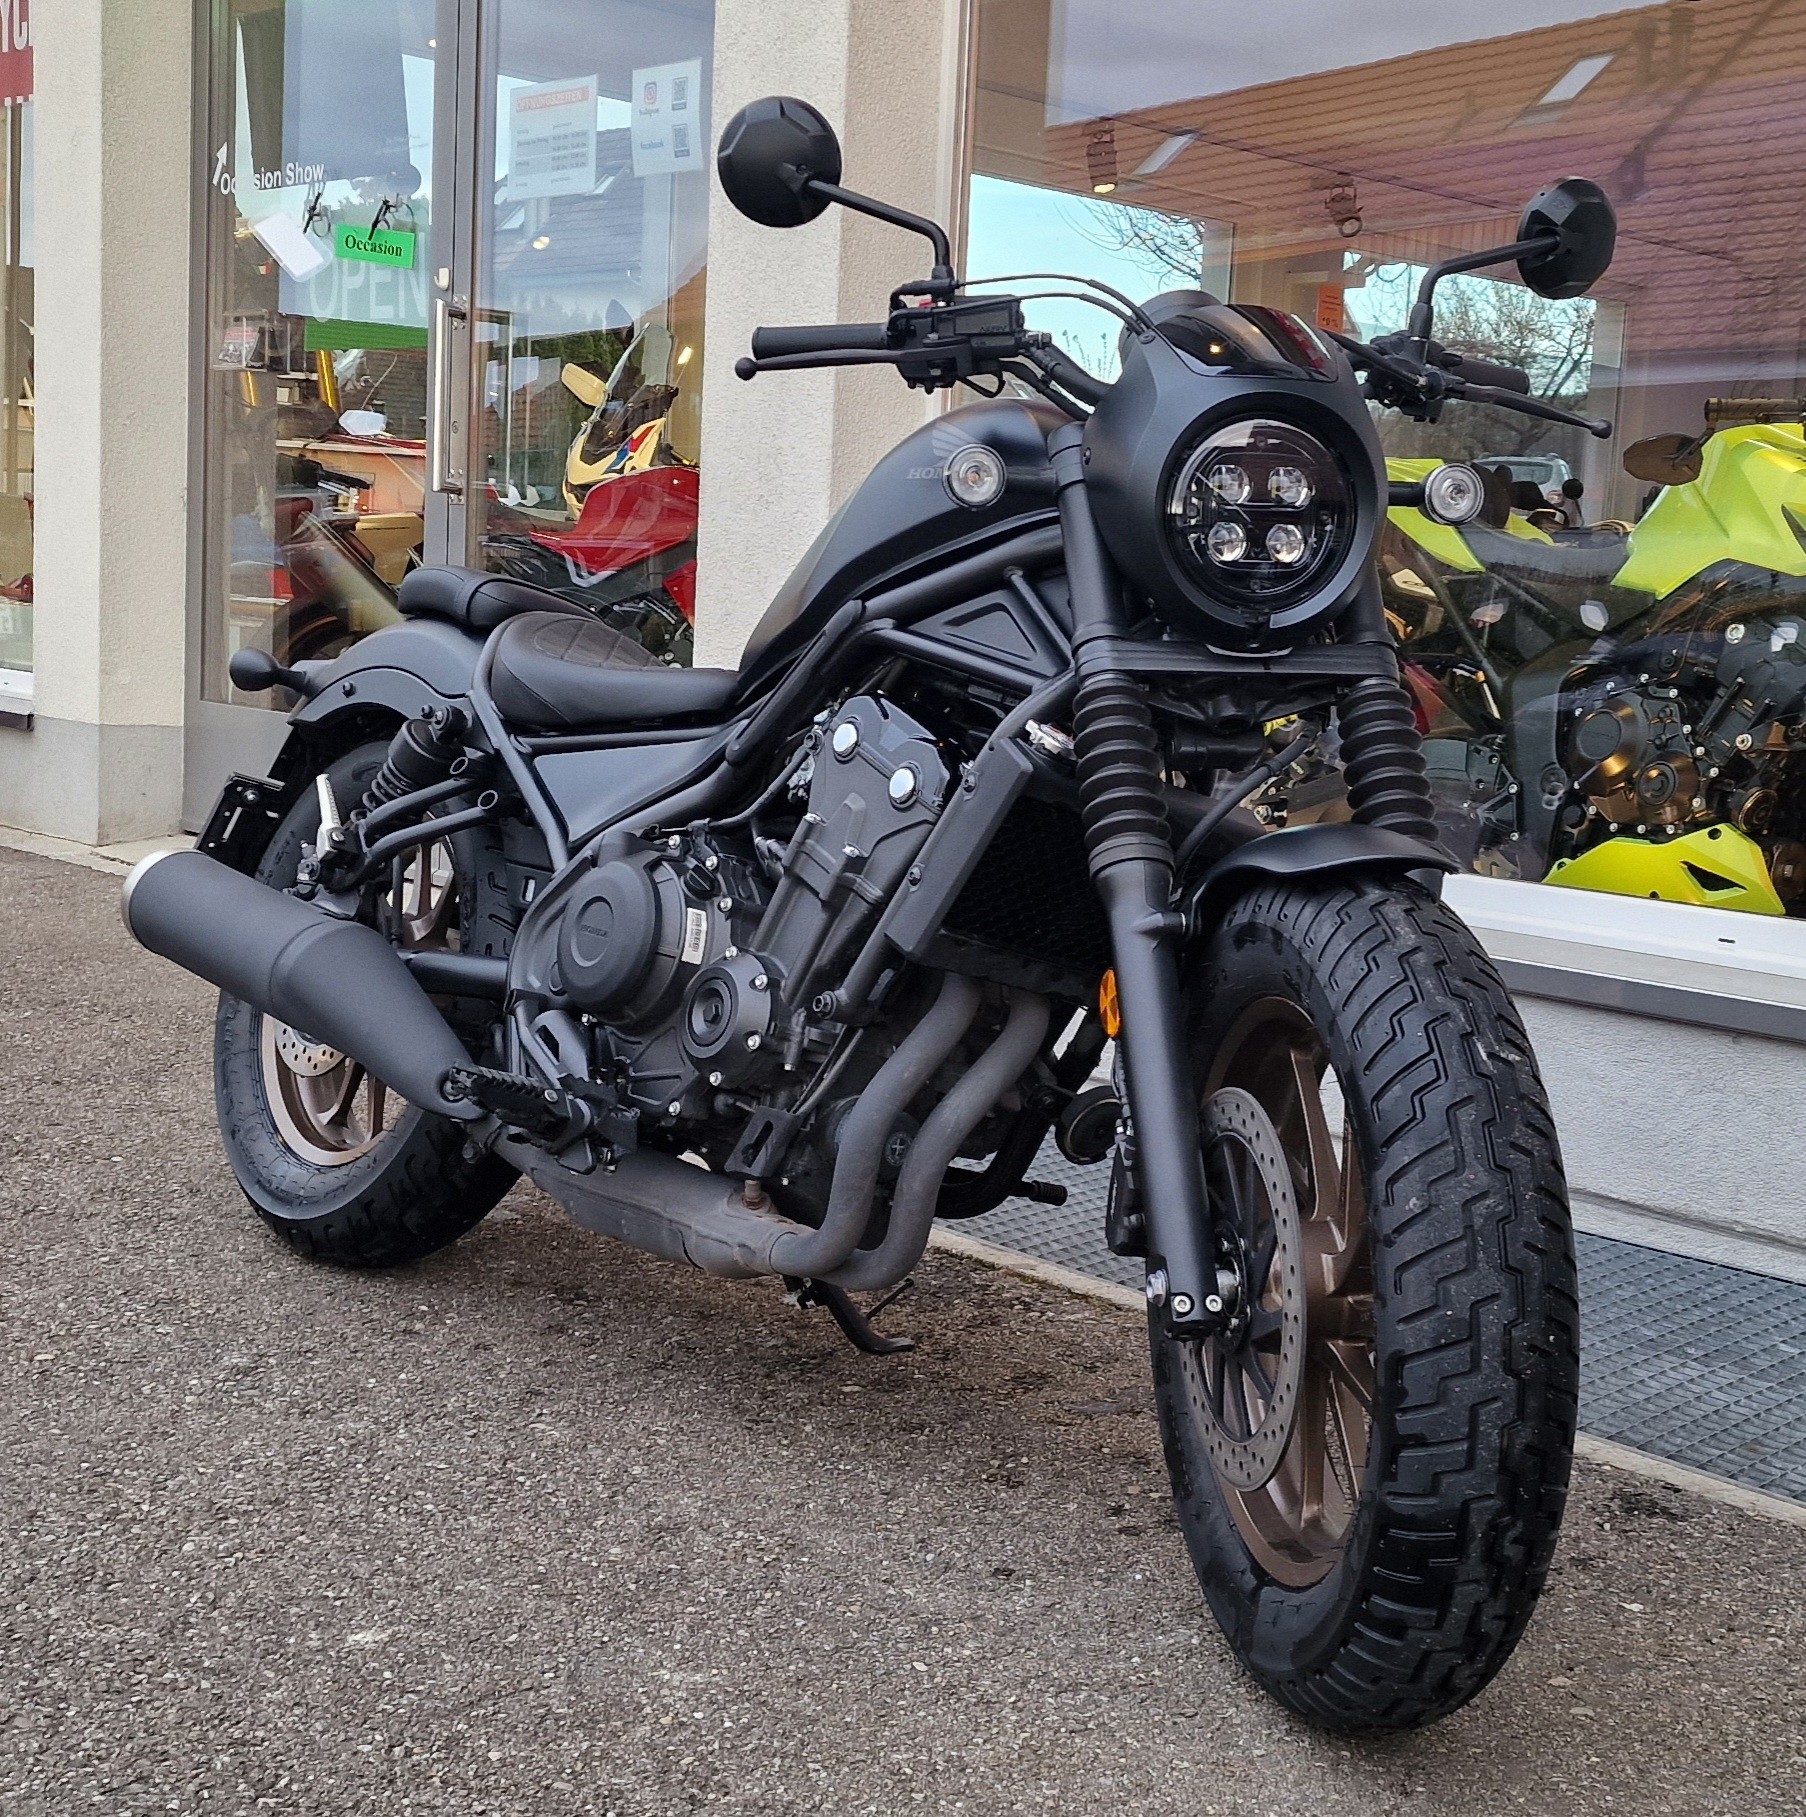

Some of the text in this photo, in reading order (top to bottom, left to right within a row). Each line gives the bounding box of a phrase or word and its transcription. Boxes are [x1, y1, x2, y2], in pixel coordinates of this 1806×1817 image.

[0, 0, 33, 52] YC
[220, 162, 325, 195] Ocsion Show
[345, 234, 403, 257] Occasion
[309, 232, 428, 323] OPEN
[906, 467, 945, 480] HON
